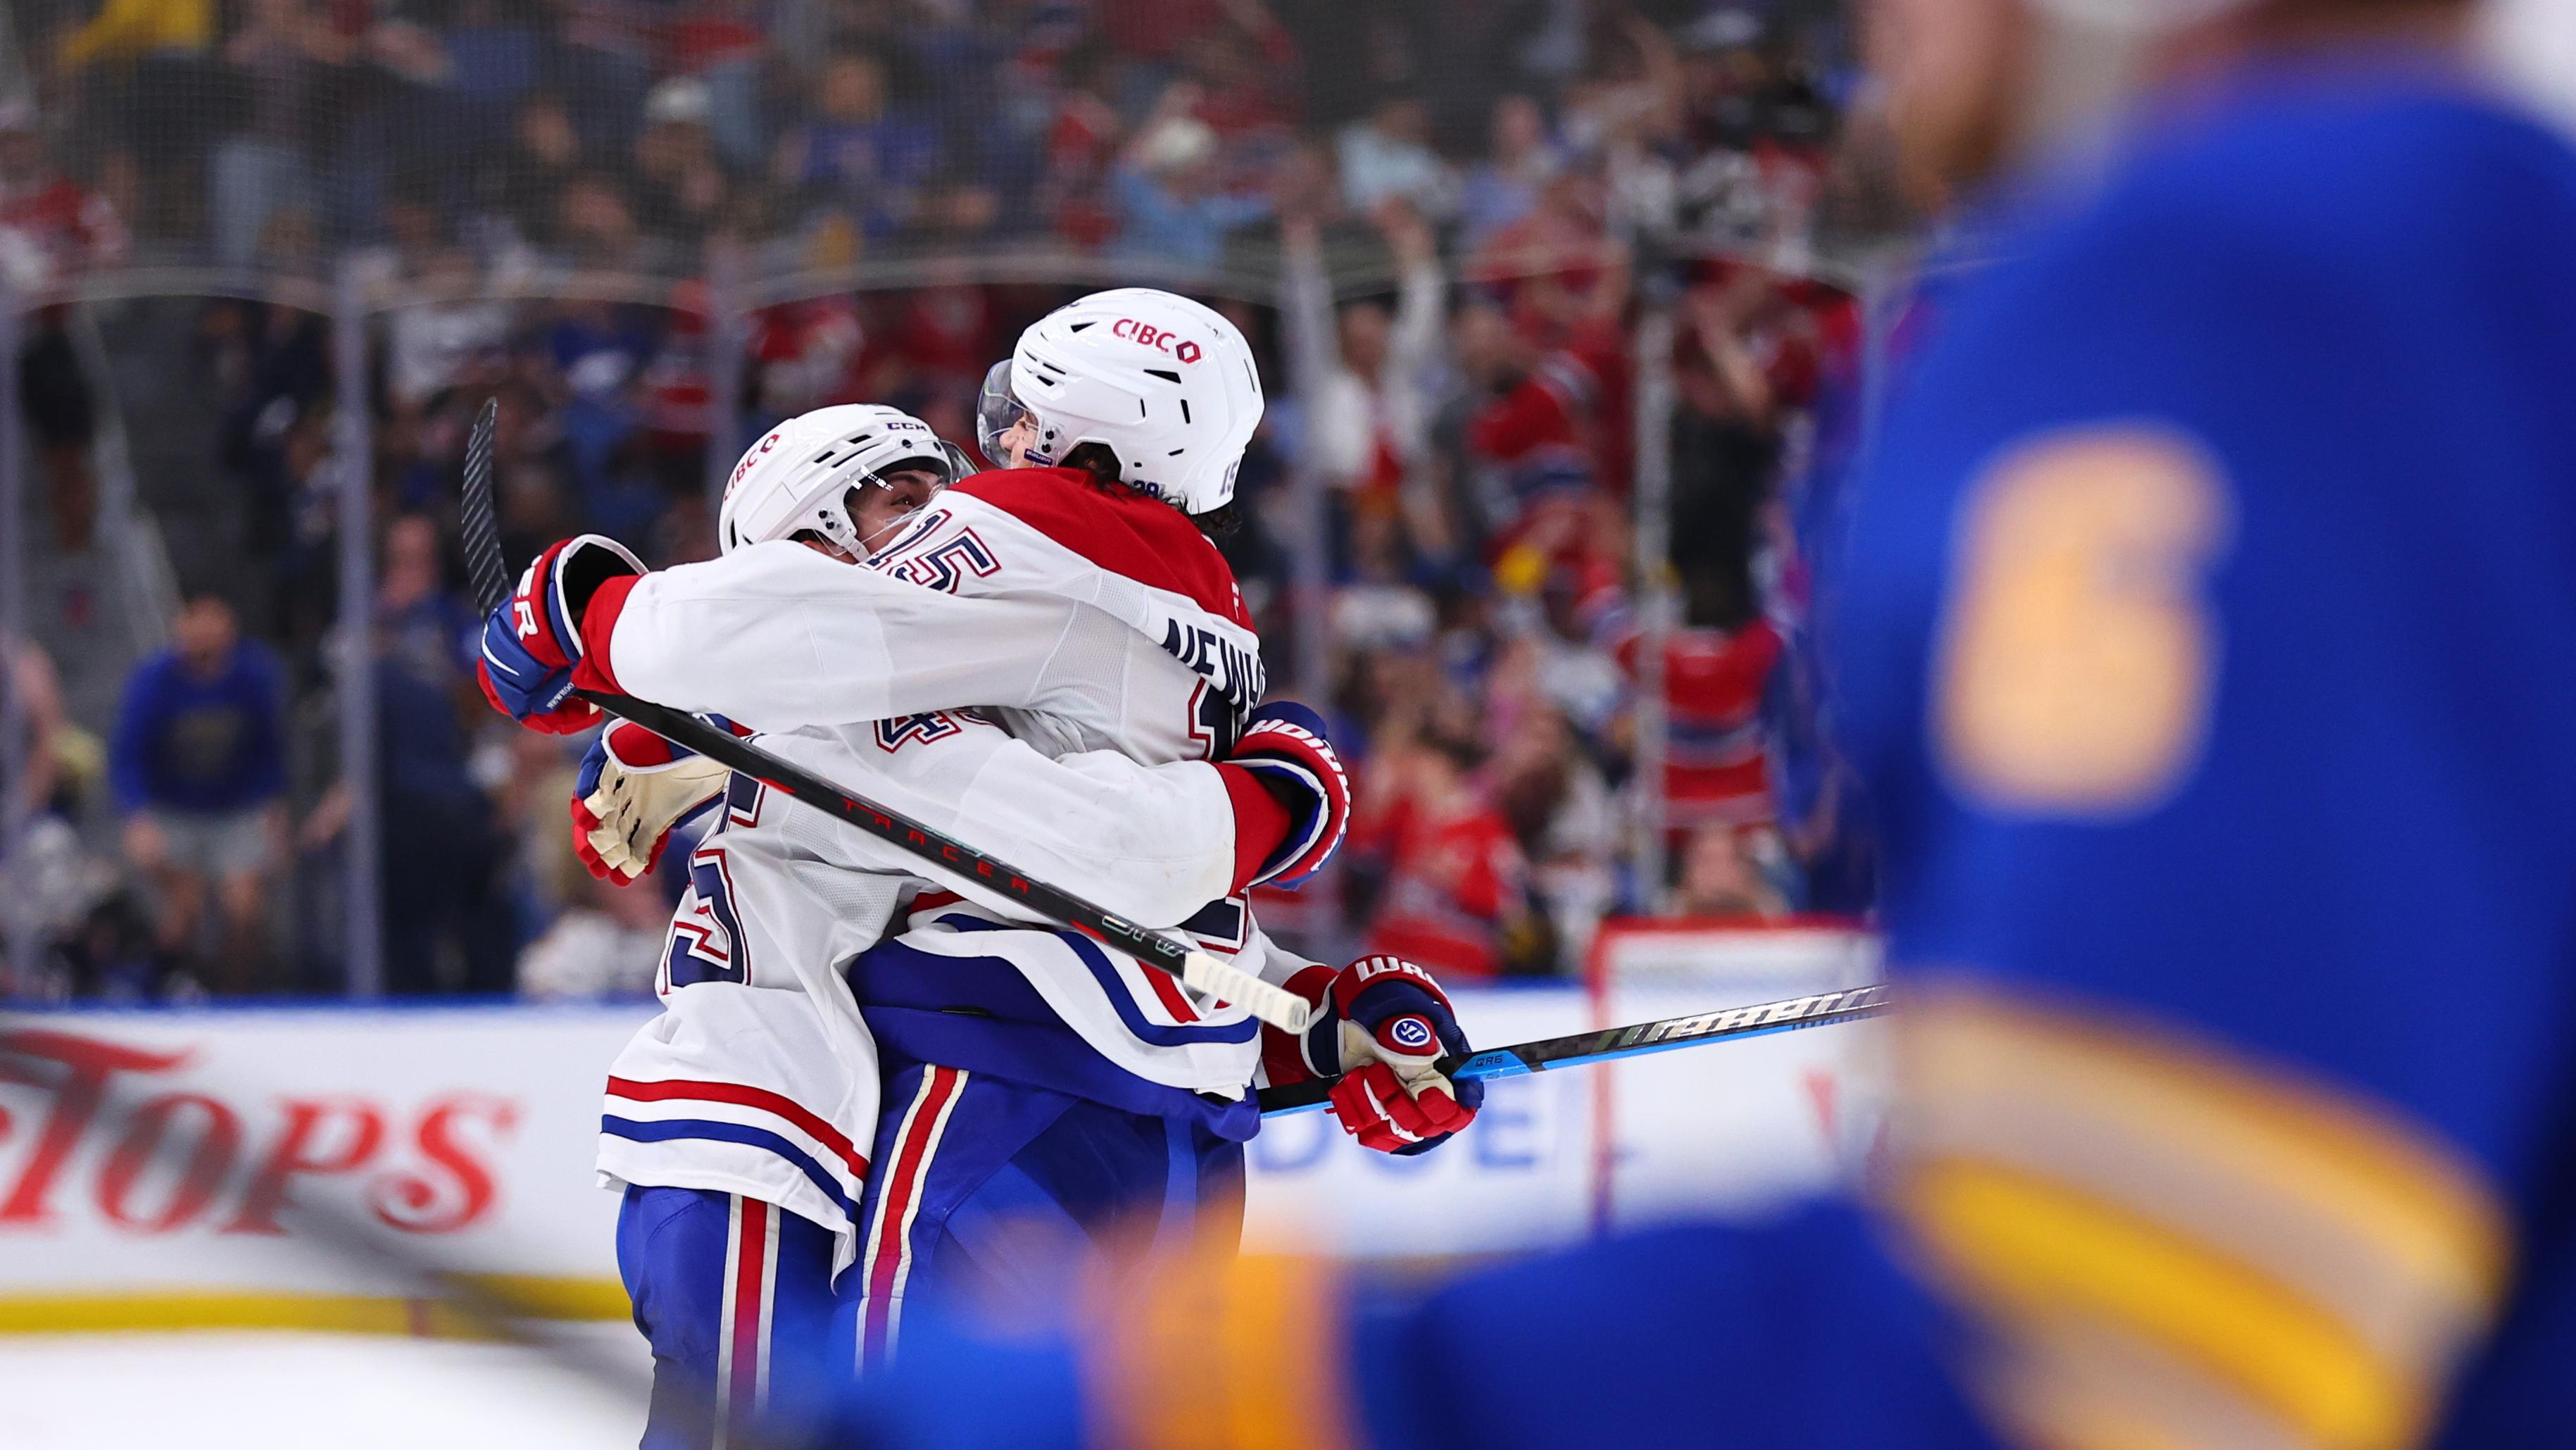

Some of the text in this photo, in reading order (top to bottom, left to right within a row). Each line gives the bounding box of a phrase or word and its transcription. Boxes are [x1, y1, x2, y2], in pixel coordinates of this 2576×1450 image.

[1112, 318, 1177, 354] CIBC
[886, 423, 927, 432] CCM
[842, 797, 1029, 894] TRACER
[0, 1028, 520, 1234] TOPS
